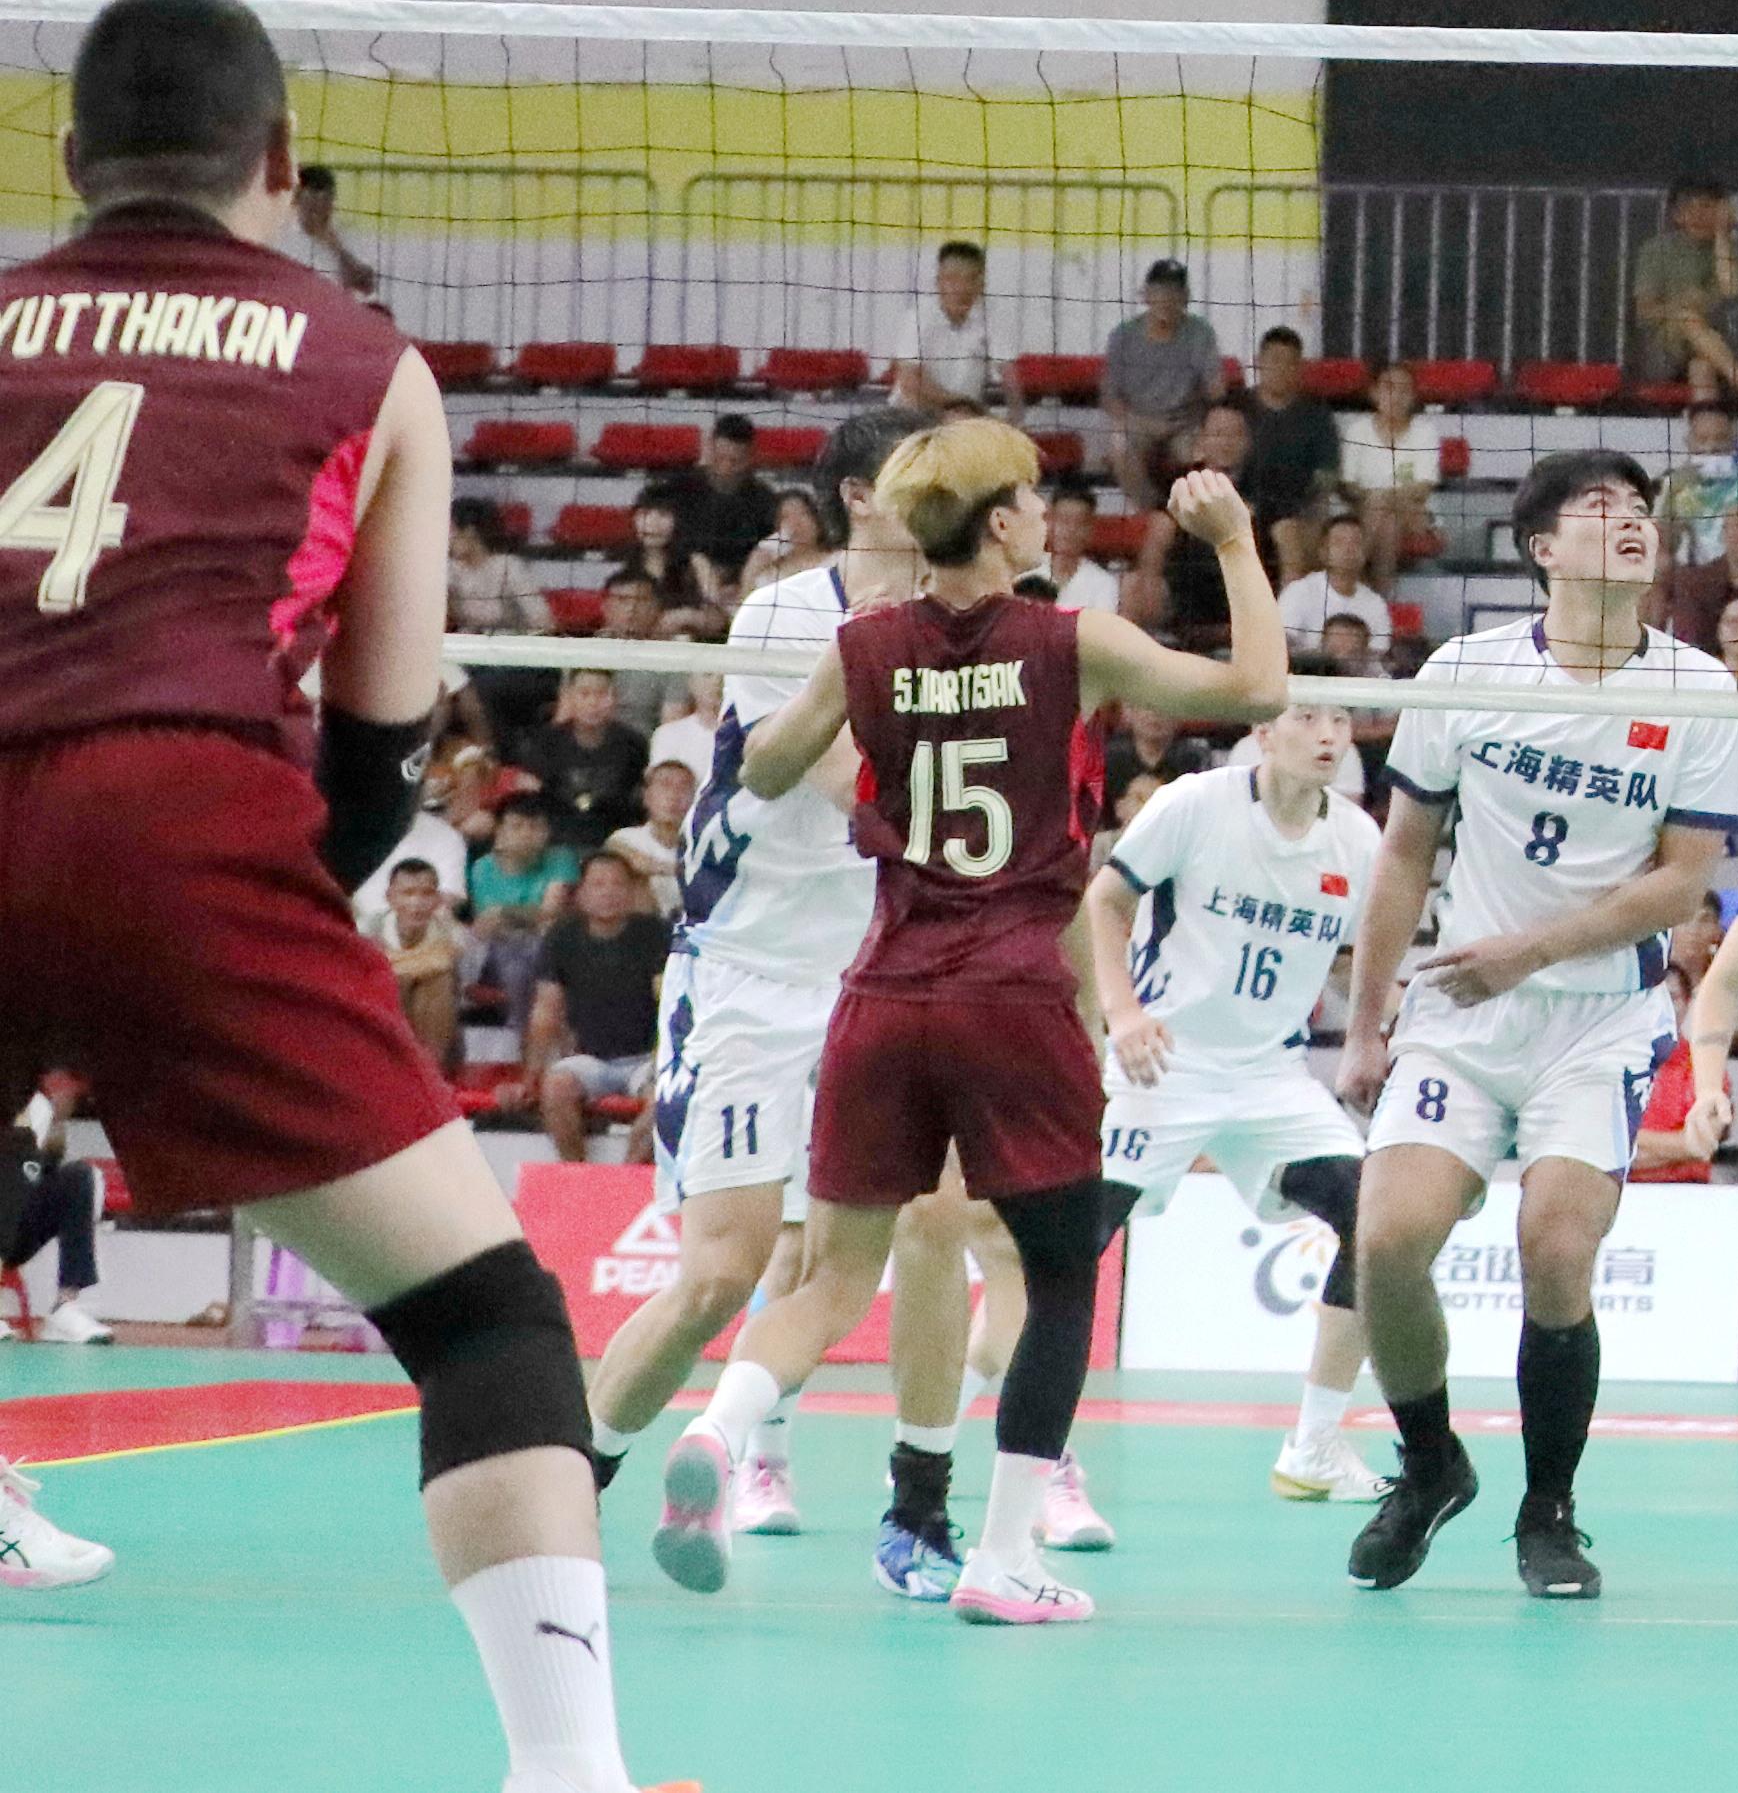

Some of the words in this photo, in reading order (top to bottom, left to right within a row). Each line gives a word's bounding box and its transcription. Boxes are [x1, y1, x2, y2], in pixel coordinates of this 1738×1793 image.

[0, 380, 145, 615] 4
[1470, 740, 1659, 811] 上海精英队
[902, 737, 1009, 878] 15
[1524, 811, 1570, 868] 8
[1203, 883, 1344, 943] 上海精英队
[1232, 940, 1284, 1002] 16
[720, 1102, 760, 1159] 11
[1415, 1076, 1449, 1124] 8
